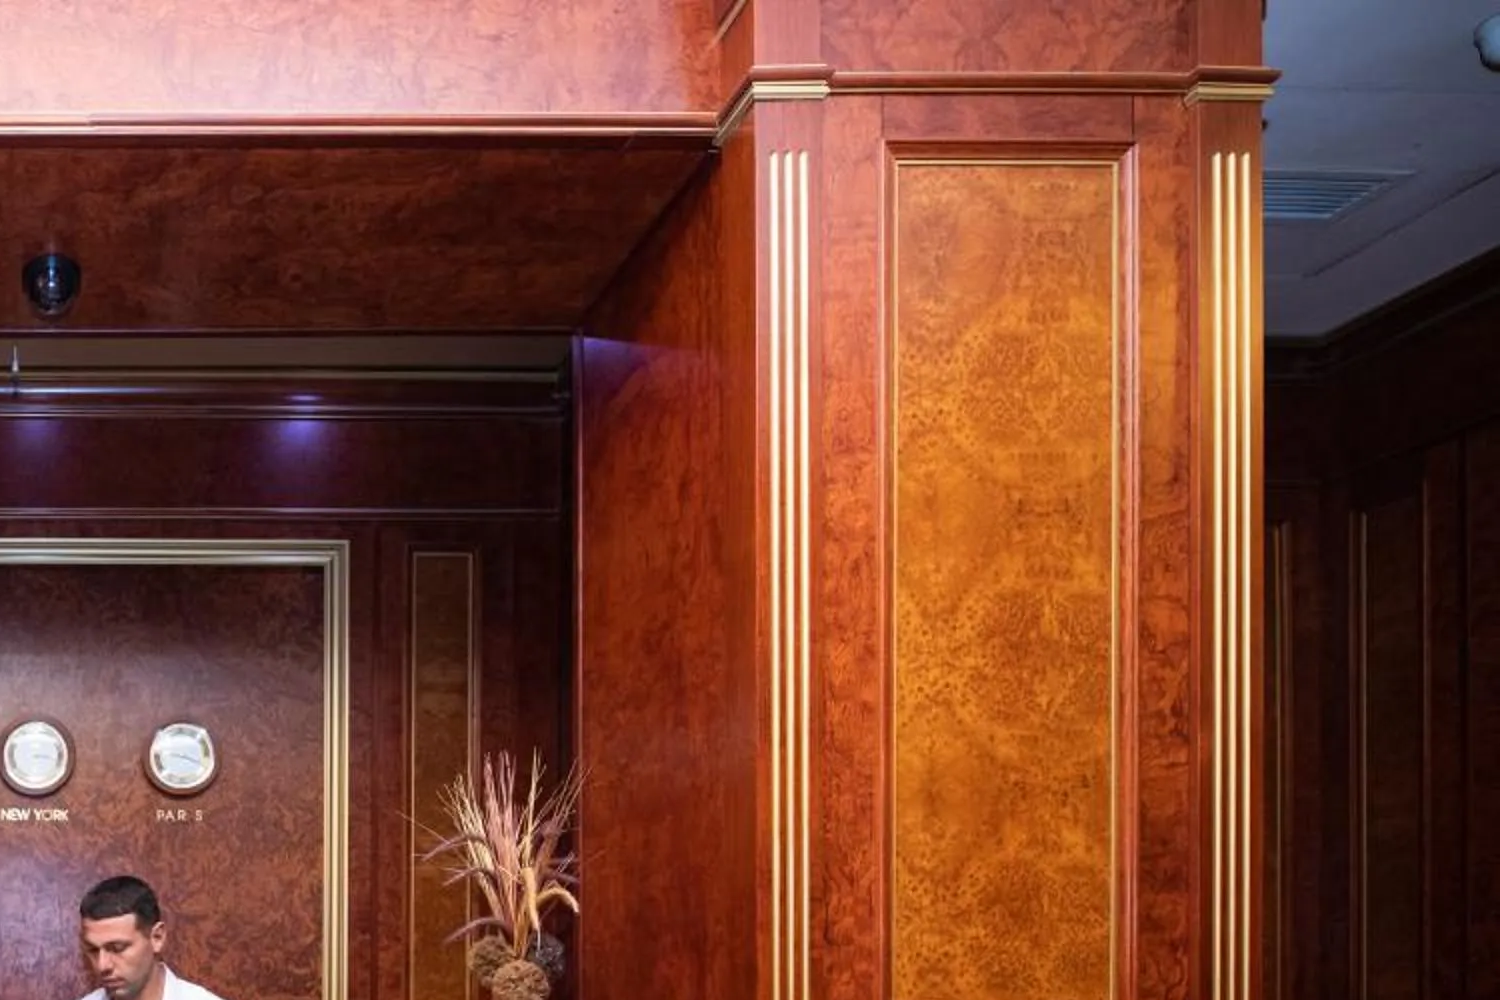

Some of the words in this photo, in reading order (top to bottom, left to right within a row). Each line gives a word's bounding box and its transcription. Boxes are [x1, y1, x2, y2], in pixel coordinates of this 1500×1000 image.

[0, 807, 31, 821] NEW
[33, 807, 69, 821] YORK
[155, 808, 203, 822] PARS
